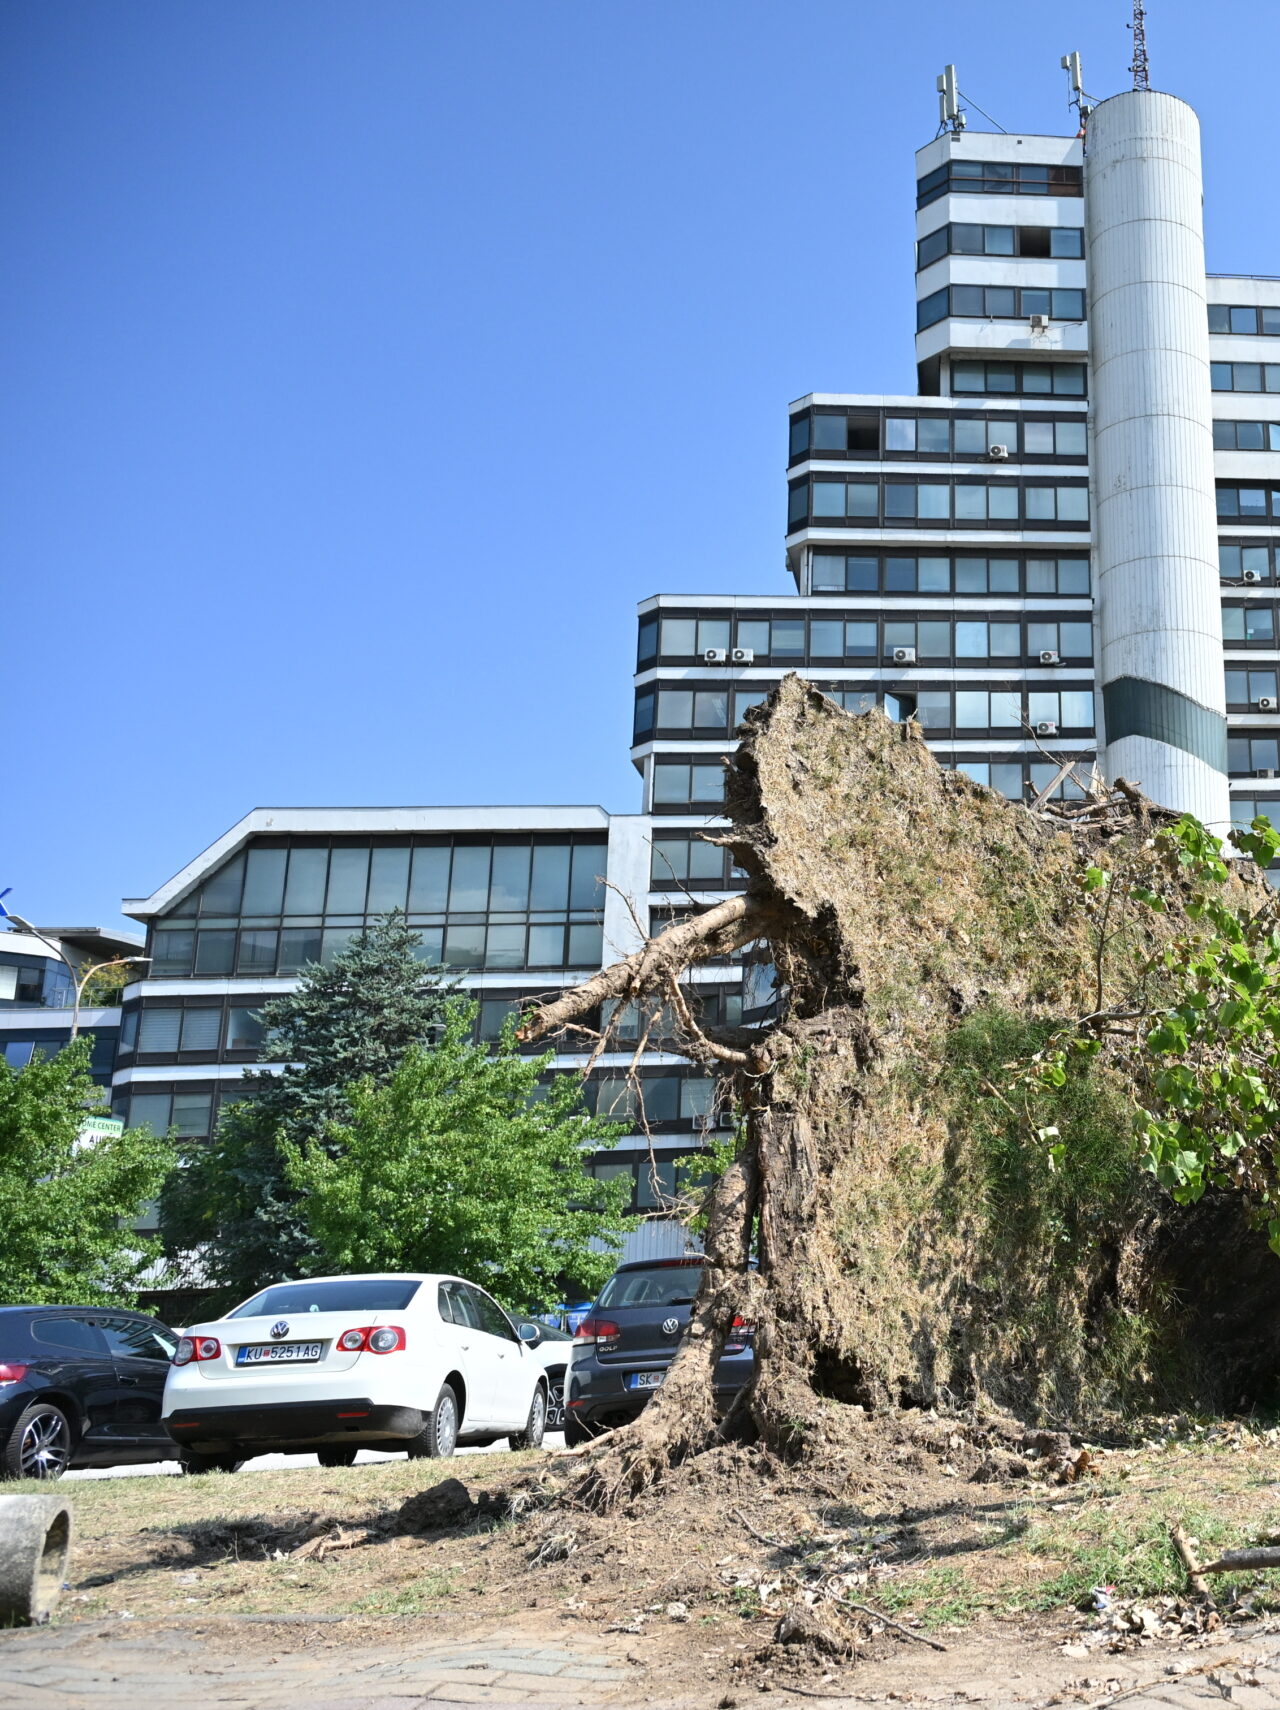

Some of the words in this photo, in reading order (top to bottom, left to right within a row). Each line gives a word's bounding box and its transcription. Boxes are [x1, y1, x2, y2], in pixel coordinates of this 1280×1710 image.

[82, 1120, 97, 1129] OME
[98, 1122, 122, 1132] CENTER
[246, 1348, 262, 1360] KU
[270, 1345, 301, 1359] 5251
[303, 1345, 319, 1357] AG
[639, 1373, 652, 1385] SK
